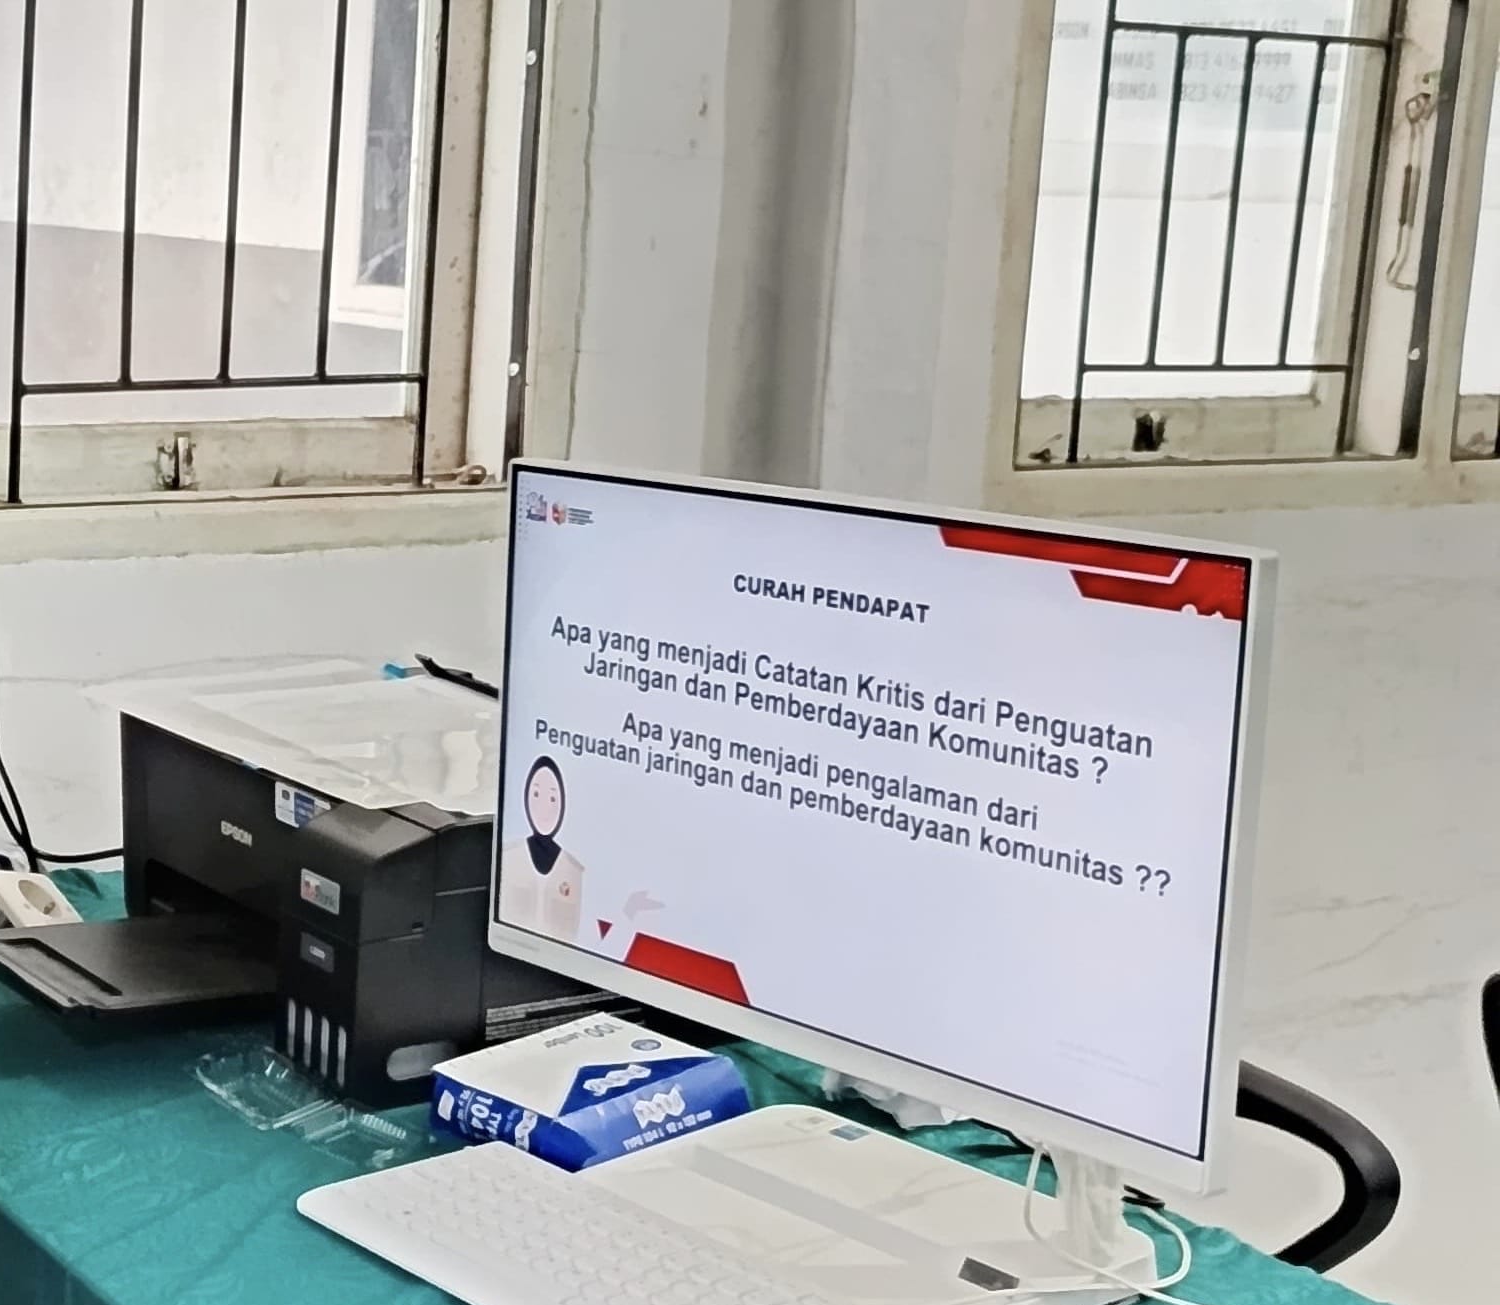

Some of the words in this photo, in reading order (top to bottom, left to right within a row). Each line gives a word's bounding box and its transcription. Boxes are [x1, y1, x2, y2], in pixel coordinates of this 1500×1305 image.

[733, 574, 806, 603] CURAH
[812, 586, 931, 624] PENDAPAT
[551, 615, 592, 646] Apa
[598, 629, 650, 662] yang
[657, 641, 747, 676] menjadi
[754, 654, 848, 696] Catatan
[856, 673, 925, 712] Kritis
[934, 690, 986, 724] dari
[995, 700, 1152, 758] Penguatan
[583, 651, 677, 693] Jaringan
[684, 673, 726, 703] dan
[734, 681, 919, 745] Pemberdayaan
[928, 721, 1080, 779] Komunitas
[535, 719, 640, 765] Penguatan
[645, 745, 734, 788] jaringan
[740, 770, 782, 801] dan
[789, 786, 970, 847] pemberdayaan
[979, 826, 1124, 886] komunitas
[622, 712, 663, 743] Apa
[669, 727, 722, 762] yang
[729, 741, 819, 779] menjadi
[826, 764, 978, 817] pengalaman
[987, 797, 1038, 831] dari
